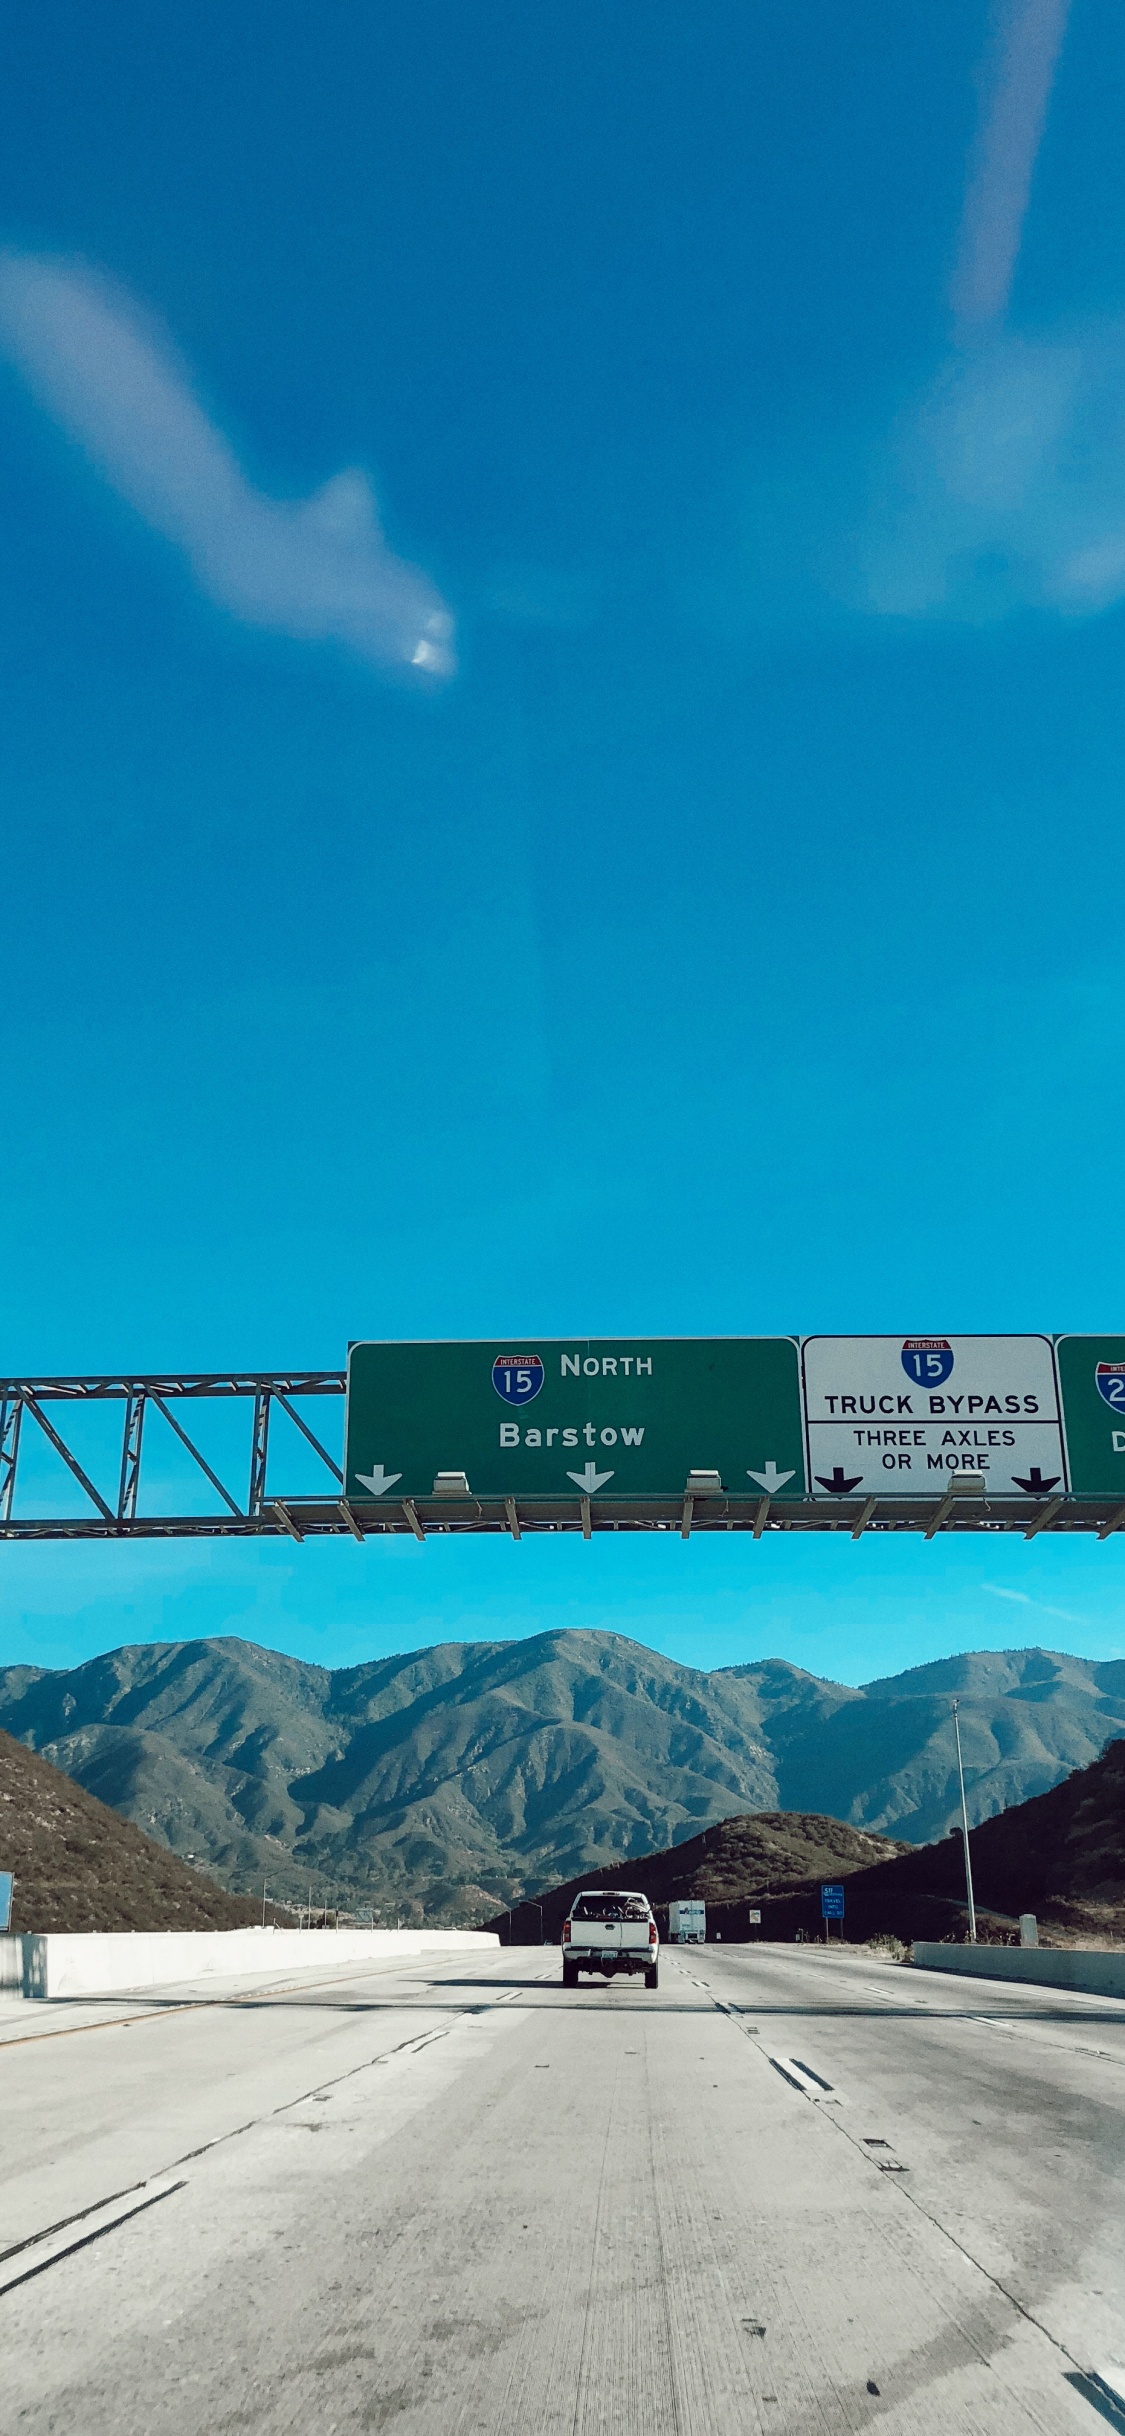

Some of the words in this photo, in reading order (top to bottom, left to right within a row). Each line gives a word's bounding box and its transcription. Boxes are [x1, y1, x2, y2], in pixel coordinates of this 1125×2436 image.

[913, 1354, 943, 1377] 15
[504, 1370, 532, 1393] 15
[825, 1395, 914, 1414] TRUCK
[928, 1395, 1040, 1414] BYPASS
[499, 1422, 645, 1447] Barstow
[853, 1430, 927, 1446] THREE
[941, 1430, 1016, 1446] AXLES
[882, 1453, 912, 1470] OR
[927, 1453, 991, 1470] MORE
